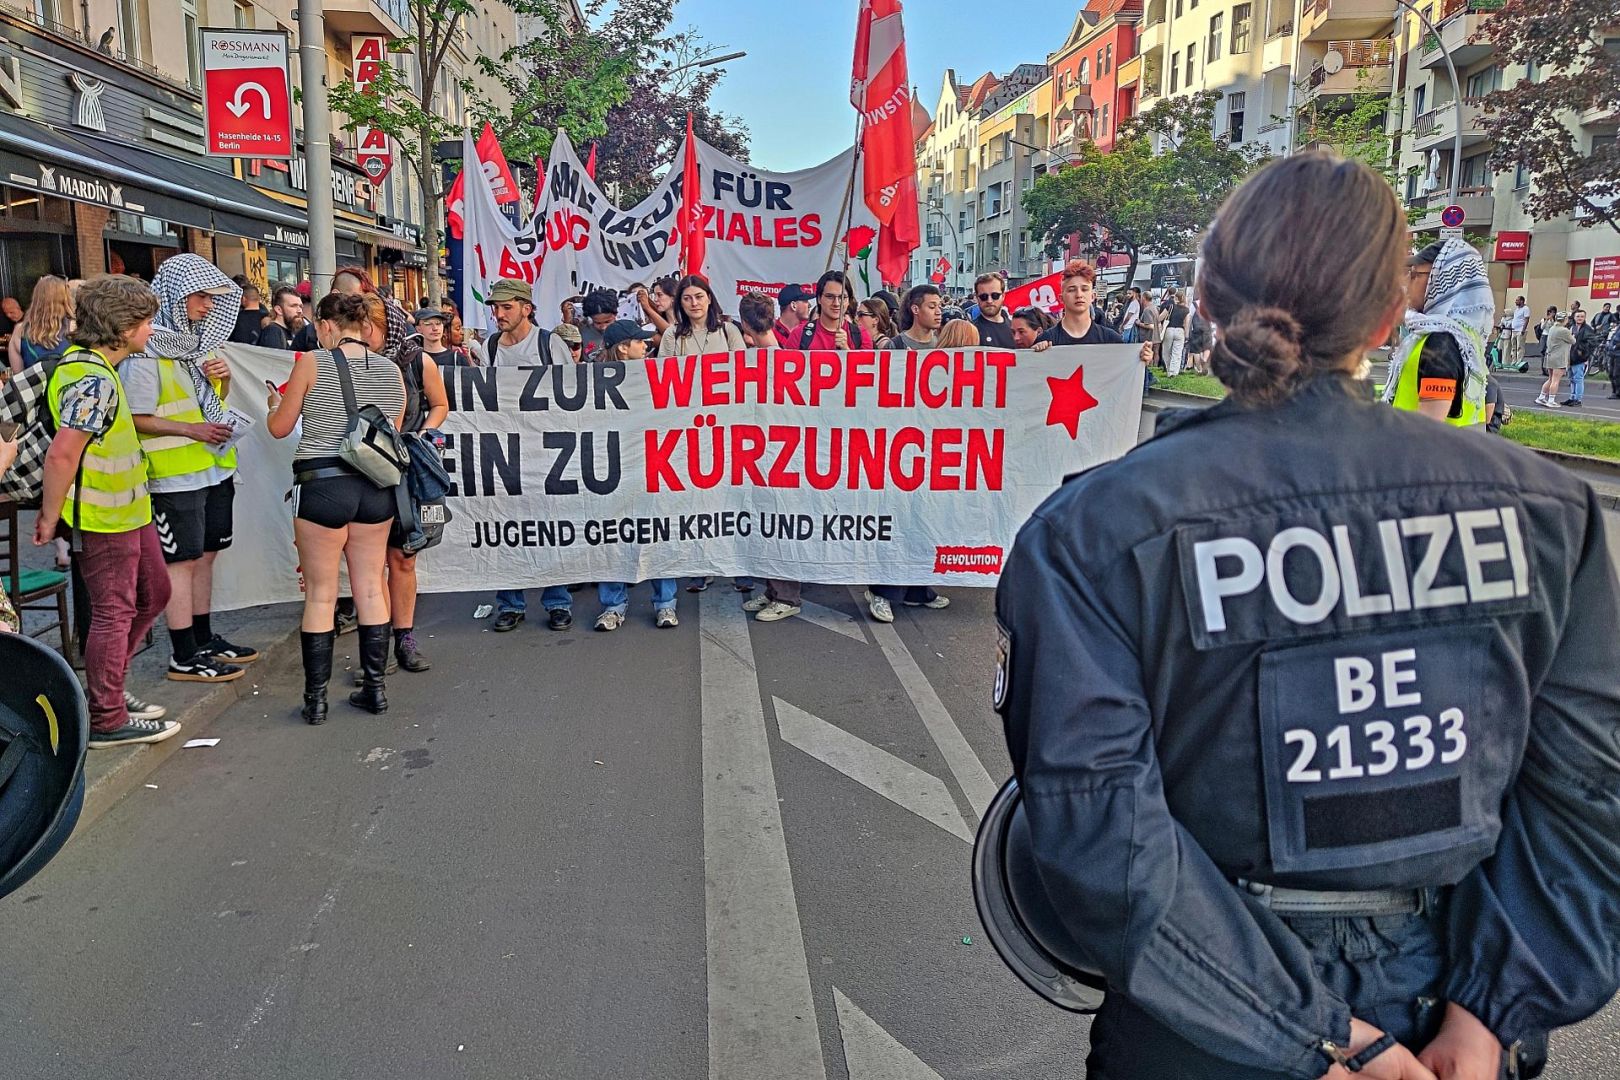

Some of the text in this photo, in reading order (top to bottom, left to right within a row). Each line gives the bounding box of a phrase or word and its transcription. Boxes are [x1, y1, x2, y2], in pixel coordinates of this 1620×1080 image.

[211, 40, 280, 53] ROSSMANN
[218, 132, 281, 142] Hasenheide 14-15
[219, 141, 240, 150] Berlin
[712, 168, 794, 211] FÜR
[600, 230, 669, 270] UND
[448, 349, 1017, 412] IN ZUR WEHRPFLICHT
[443, 414, 1005, 497] EIN ZU KÜRZUNGEN
[471, 511, 892, 549] JUGEND GEGEN KRIEG UND KRISE
[939, 552, 999, 566] REVOLUTION
[1193, 506, 1530, 632] POLIZEI
[1334, 648, 1422, 714] BE
[1284, 707, 1467, 783] 21333
